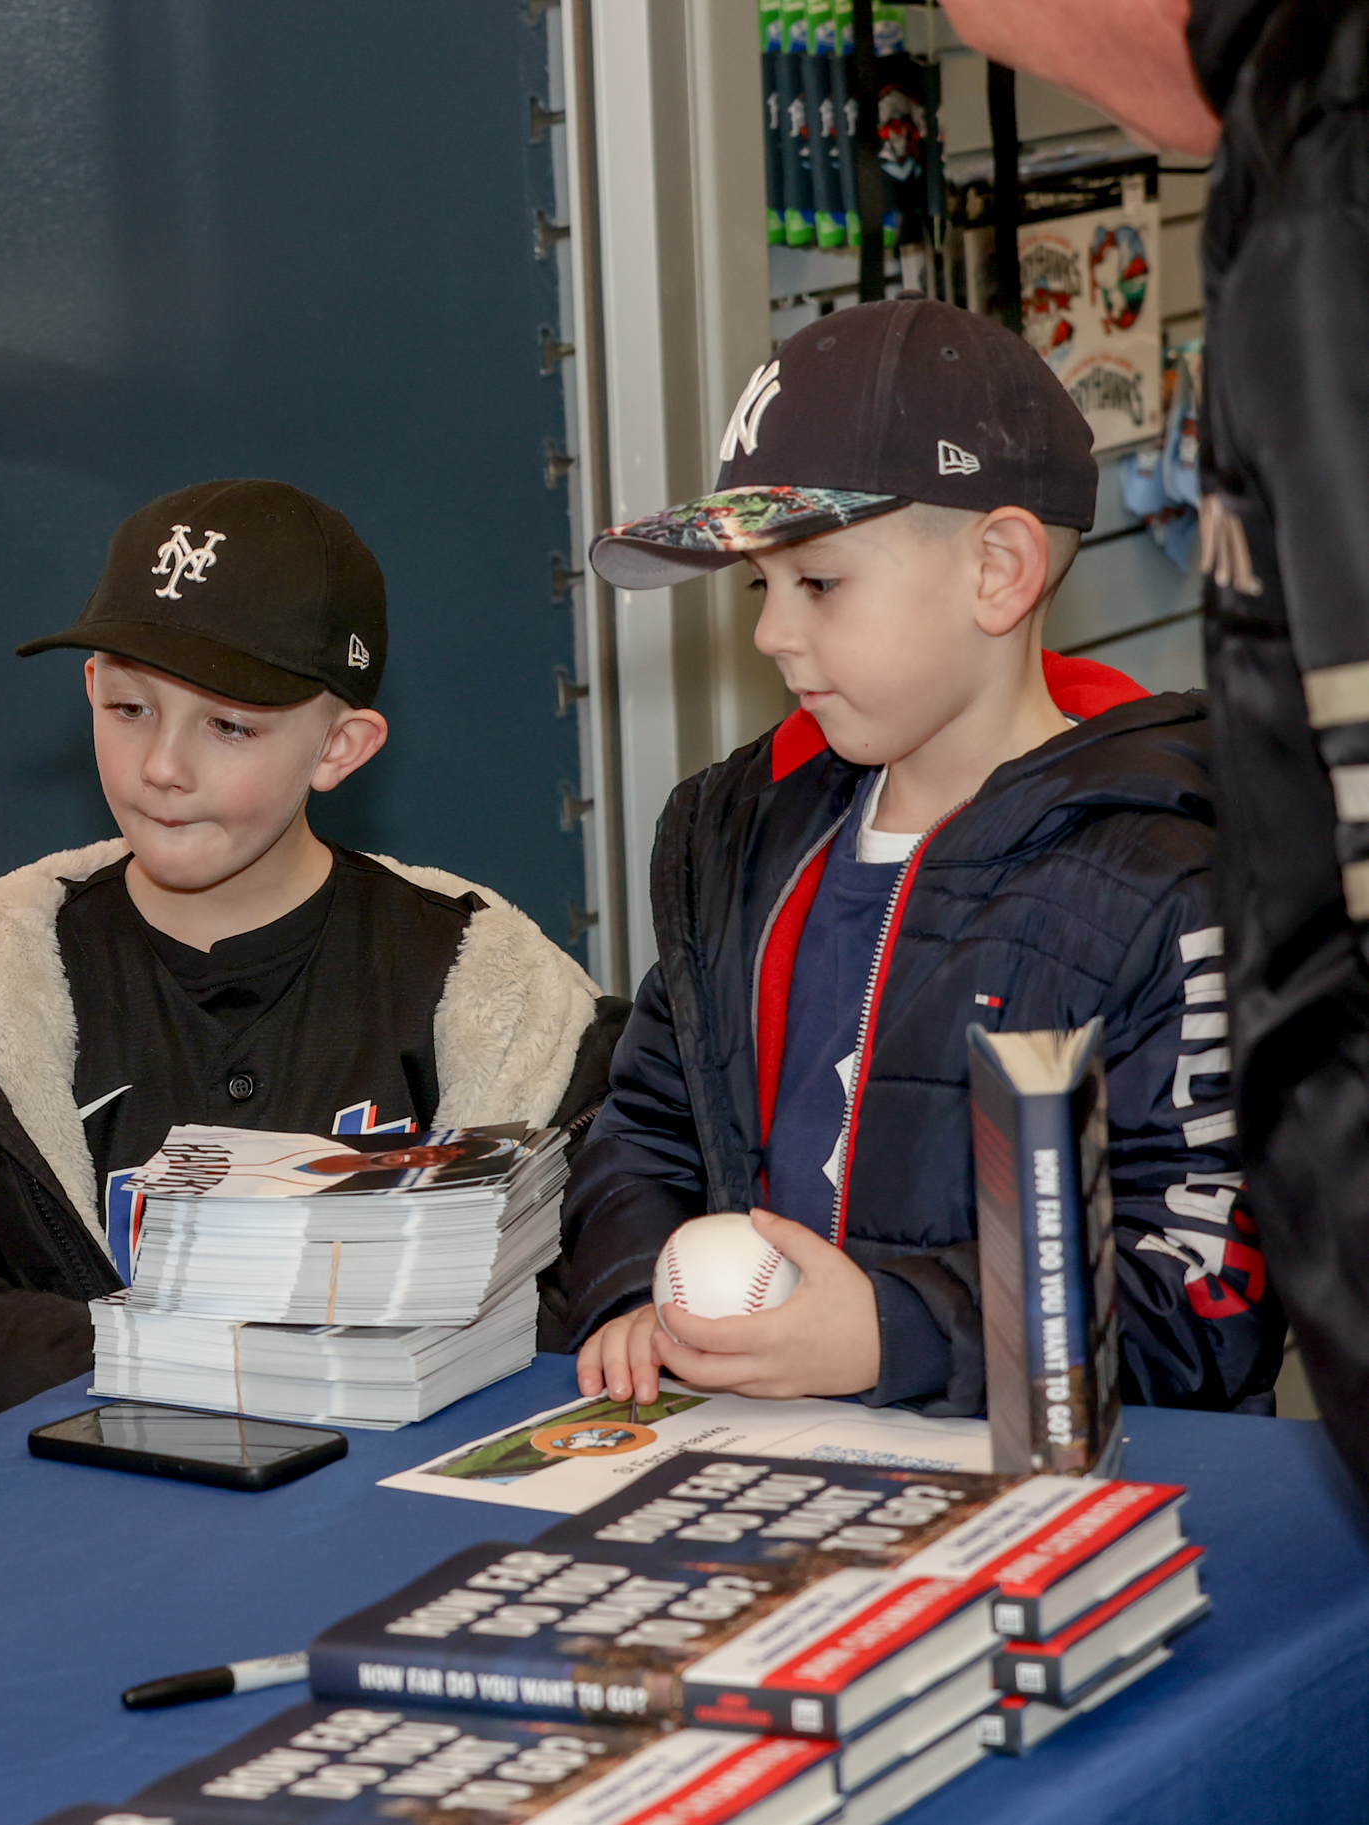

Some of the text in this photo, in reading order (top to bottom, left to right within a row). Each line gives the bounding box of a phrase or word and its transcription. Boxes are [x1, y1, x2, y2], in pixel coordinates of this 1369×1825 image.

[150, 524, 227, 601] NY
[1034, 1148, 1072, 1446] HOW FAR DO YOU WANT TO GO?
[595, 1462, 771, 1544] HOW FAR
[675, 1473, 827, 1543] DO YOU
[758, 1485, 884, 1539] WANT
[818, 1525, 904, 1551] TO
[385, 1551, 574, 1638] HOW FAR
[469, 1562, 630, 1638] DO YOU
[553, 1575, 689, 1634] WANT
[614, 1618, 706, 1647] TO
[358, 1662, 650, 1715] HOW FAR DO YOU WANT TO GO?
[290, 1708, 404, 1751] FAR
[345, 1721, 461, 1765] YOU
